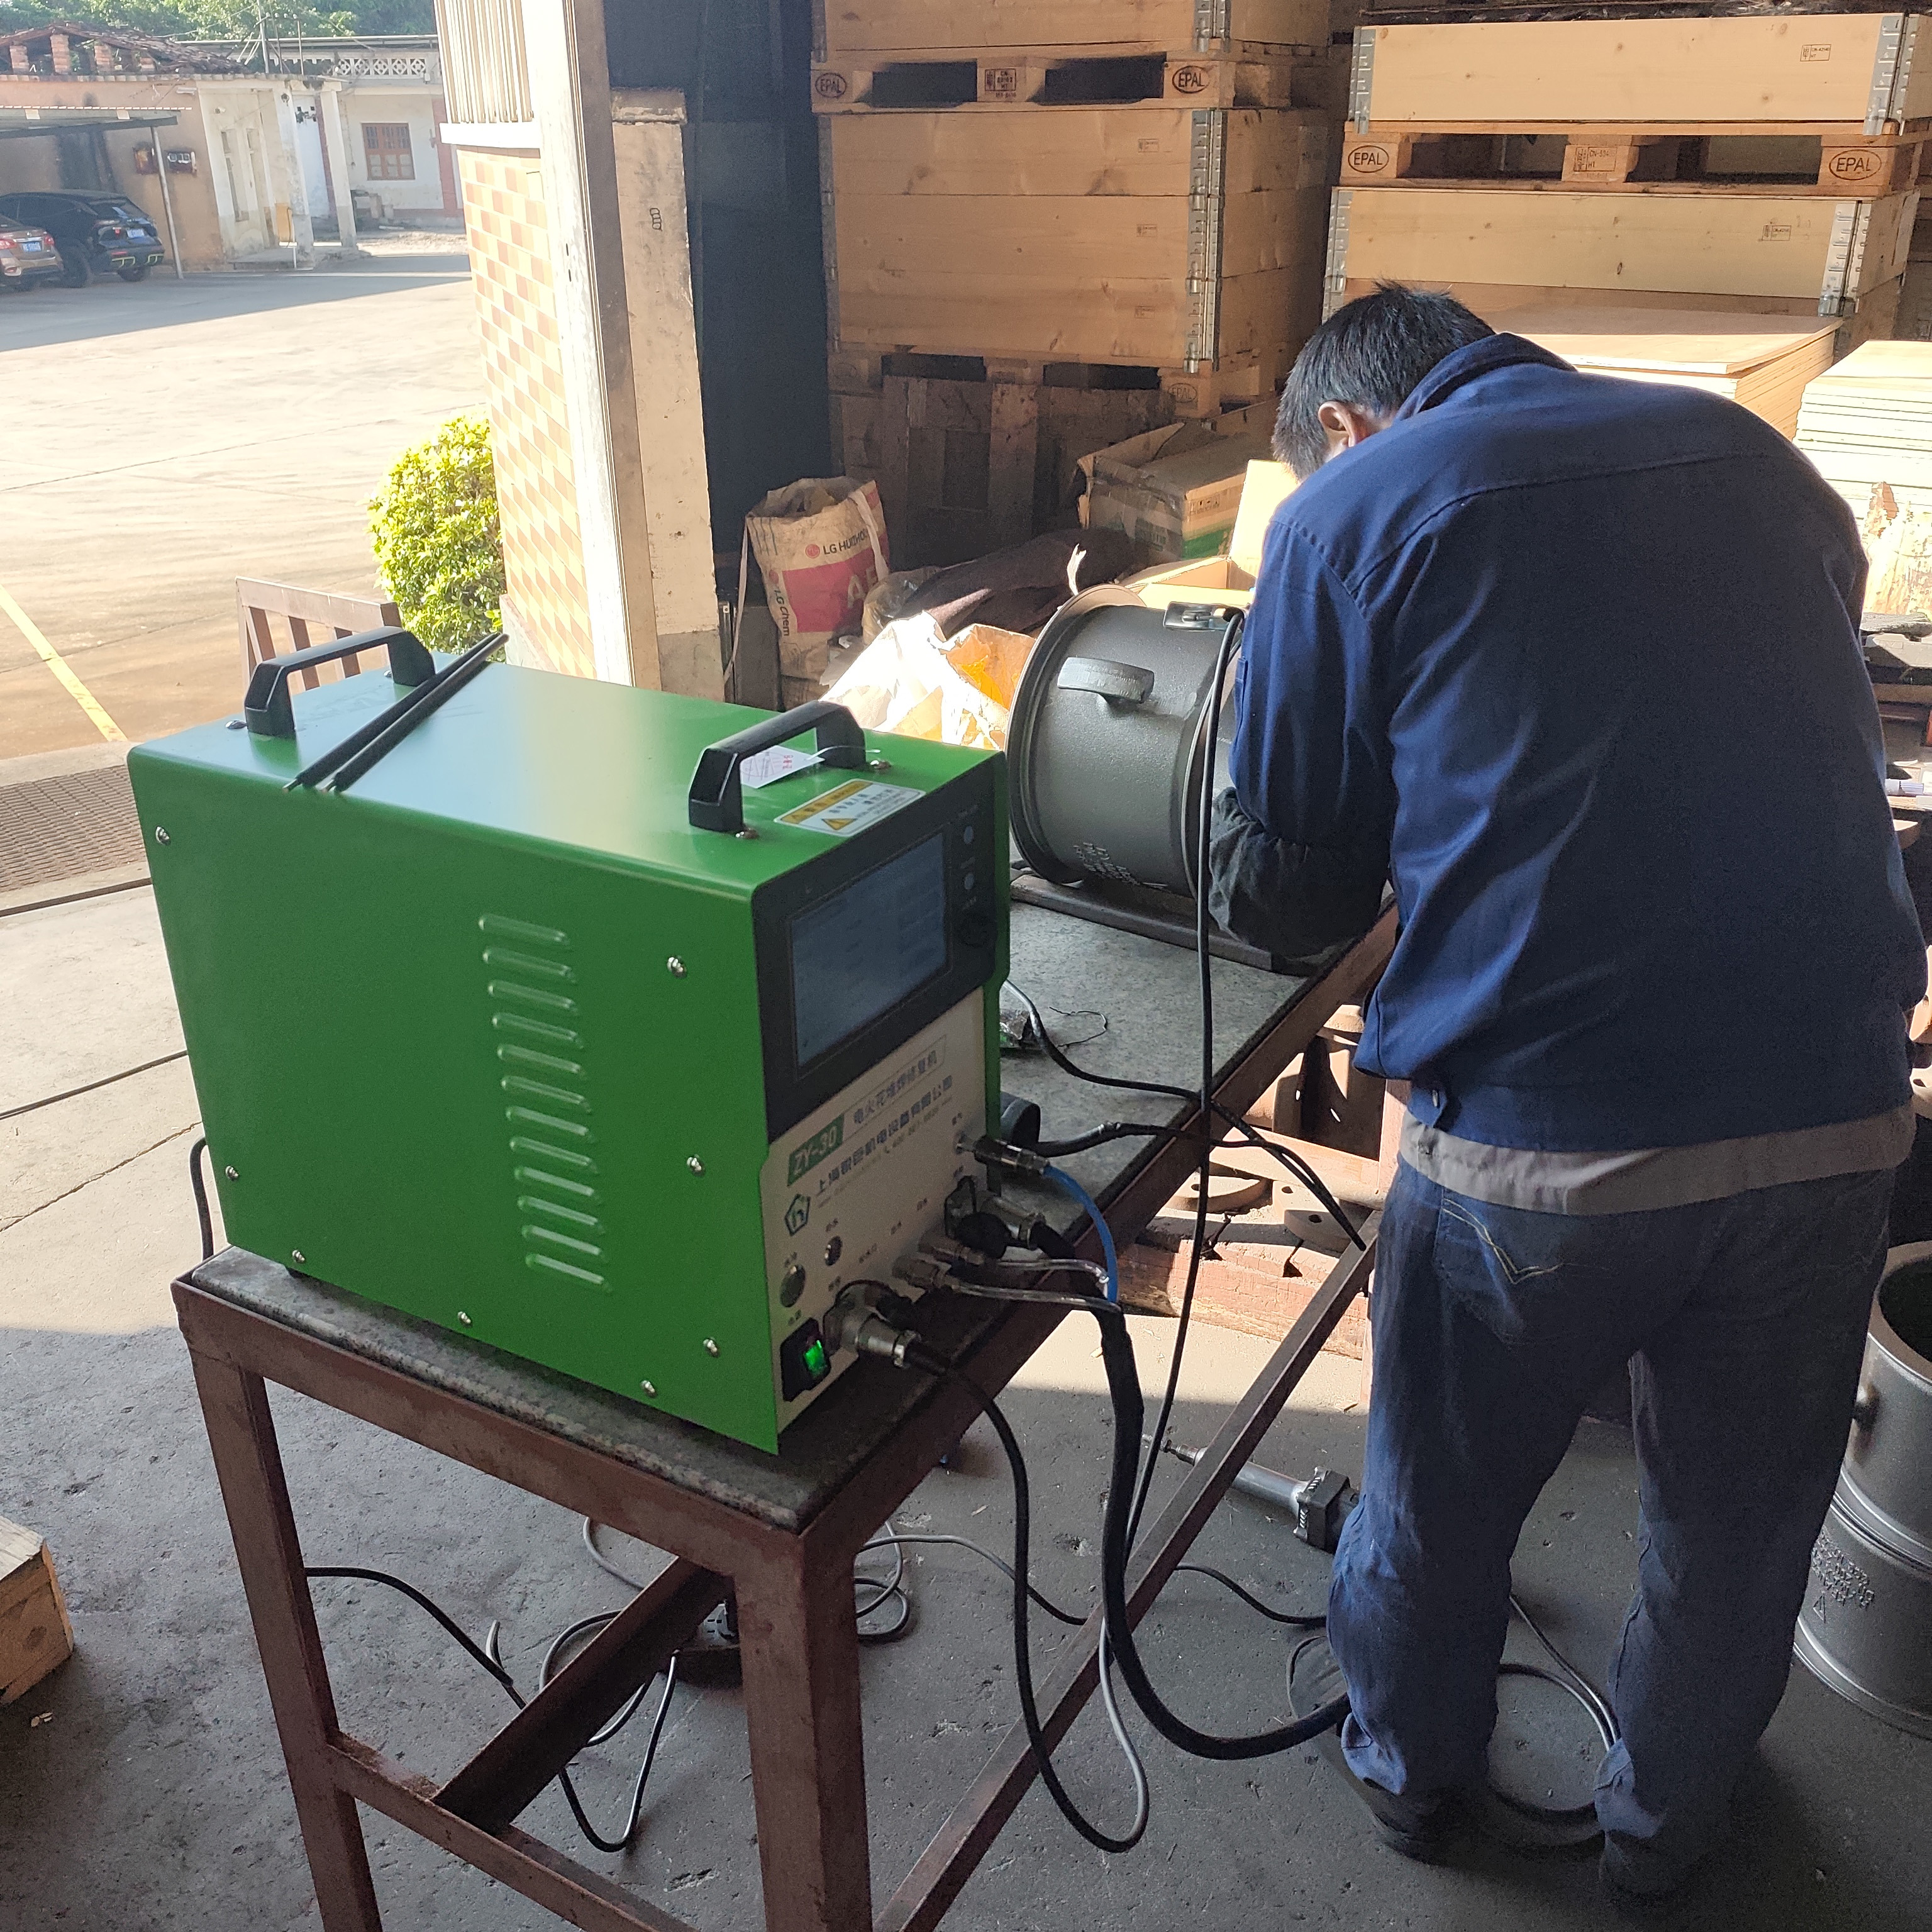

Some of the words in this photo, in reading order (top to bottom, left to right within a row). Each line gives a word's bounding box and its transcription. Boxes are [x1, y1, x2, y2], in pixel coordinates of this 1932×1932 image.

[820, 78, 841, 94] EPAL
[1178, 72, 1206, 87] EPAL
[1353, 152, 1383, 165] EPAL
[1836, 157, 1872, 172] EPAL
[823, 543, 837, 555] LG
[774, 590, 785, 604] LG
[780, 606, 791, 636] Chem
[792, 1124, 838, 1176] ZY-30
